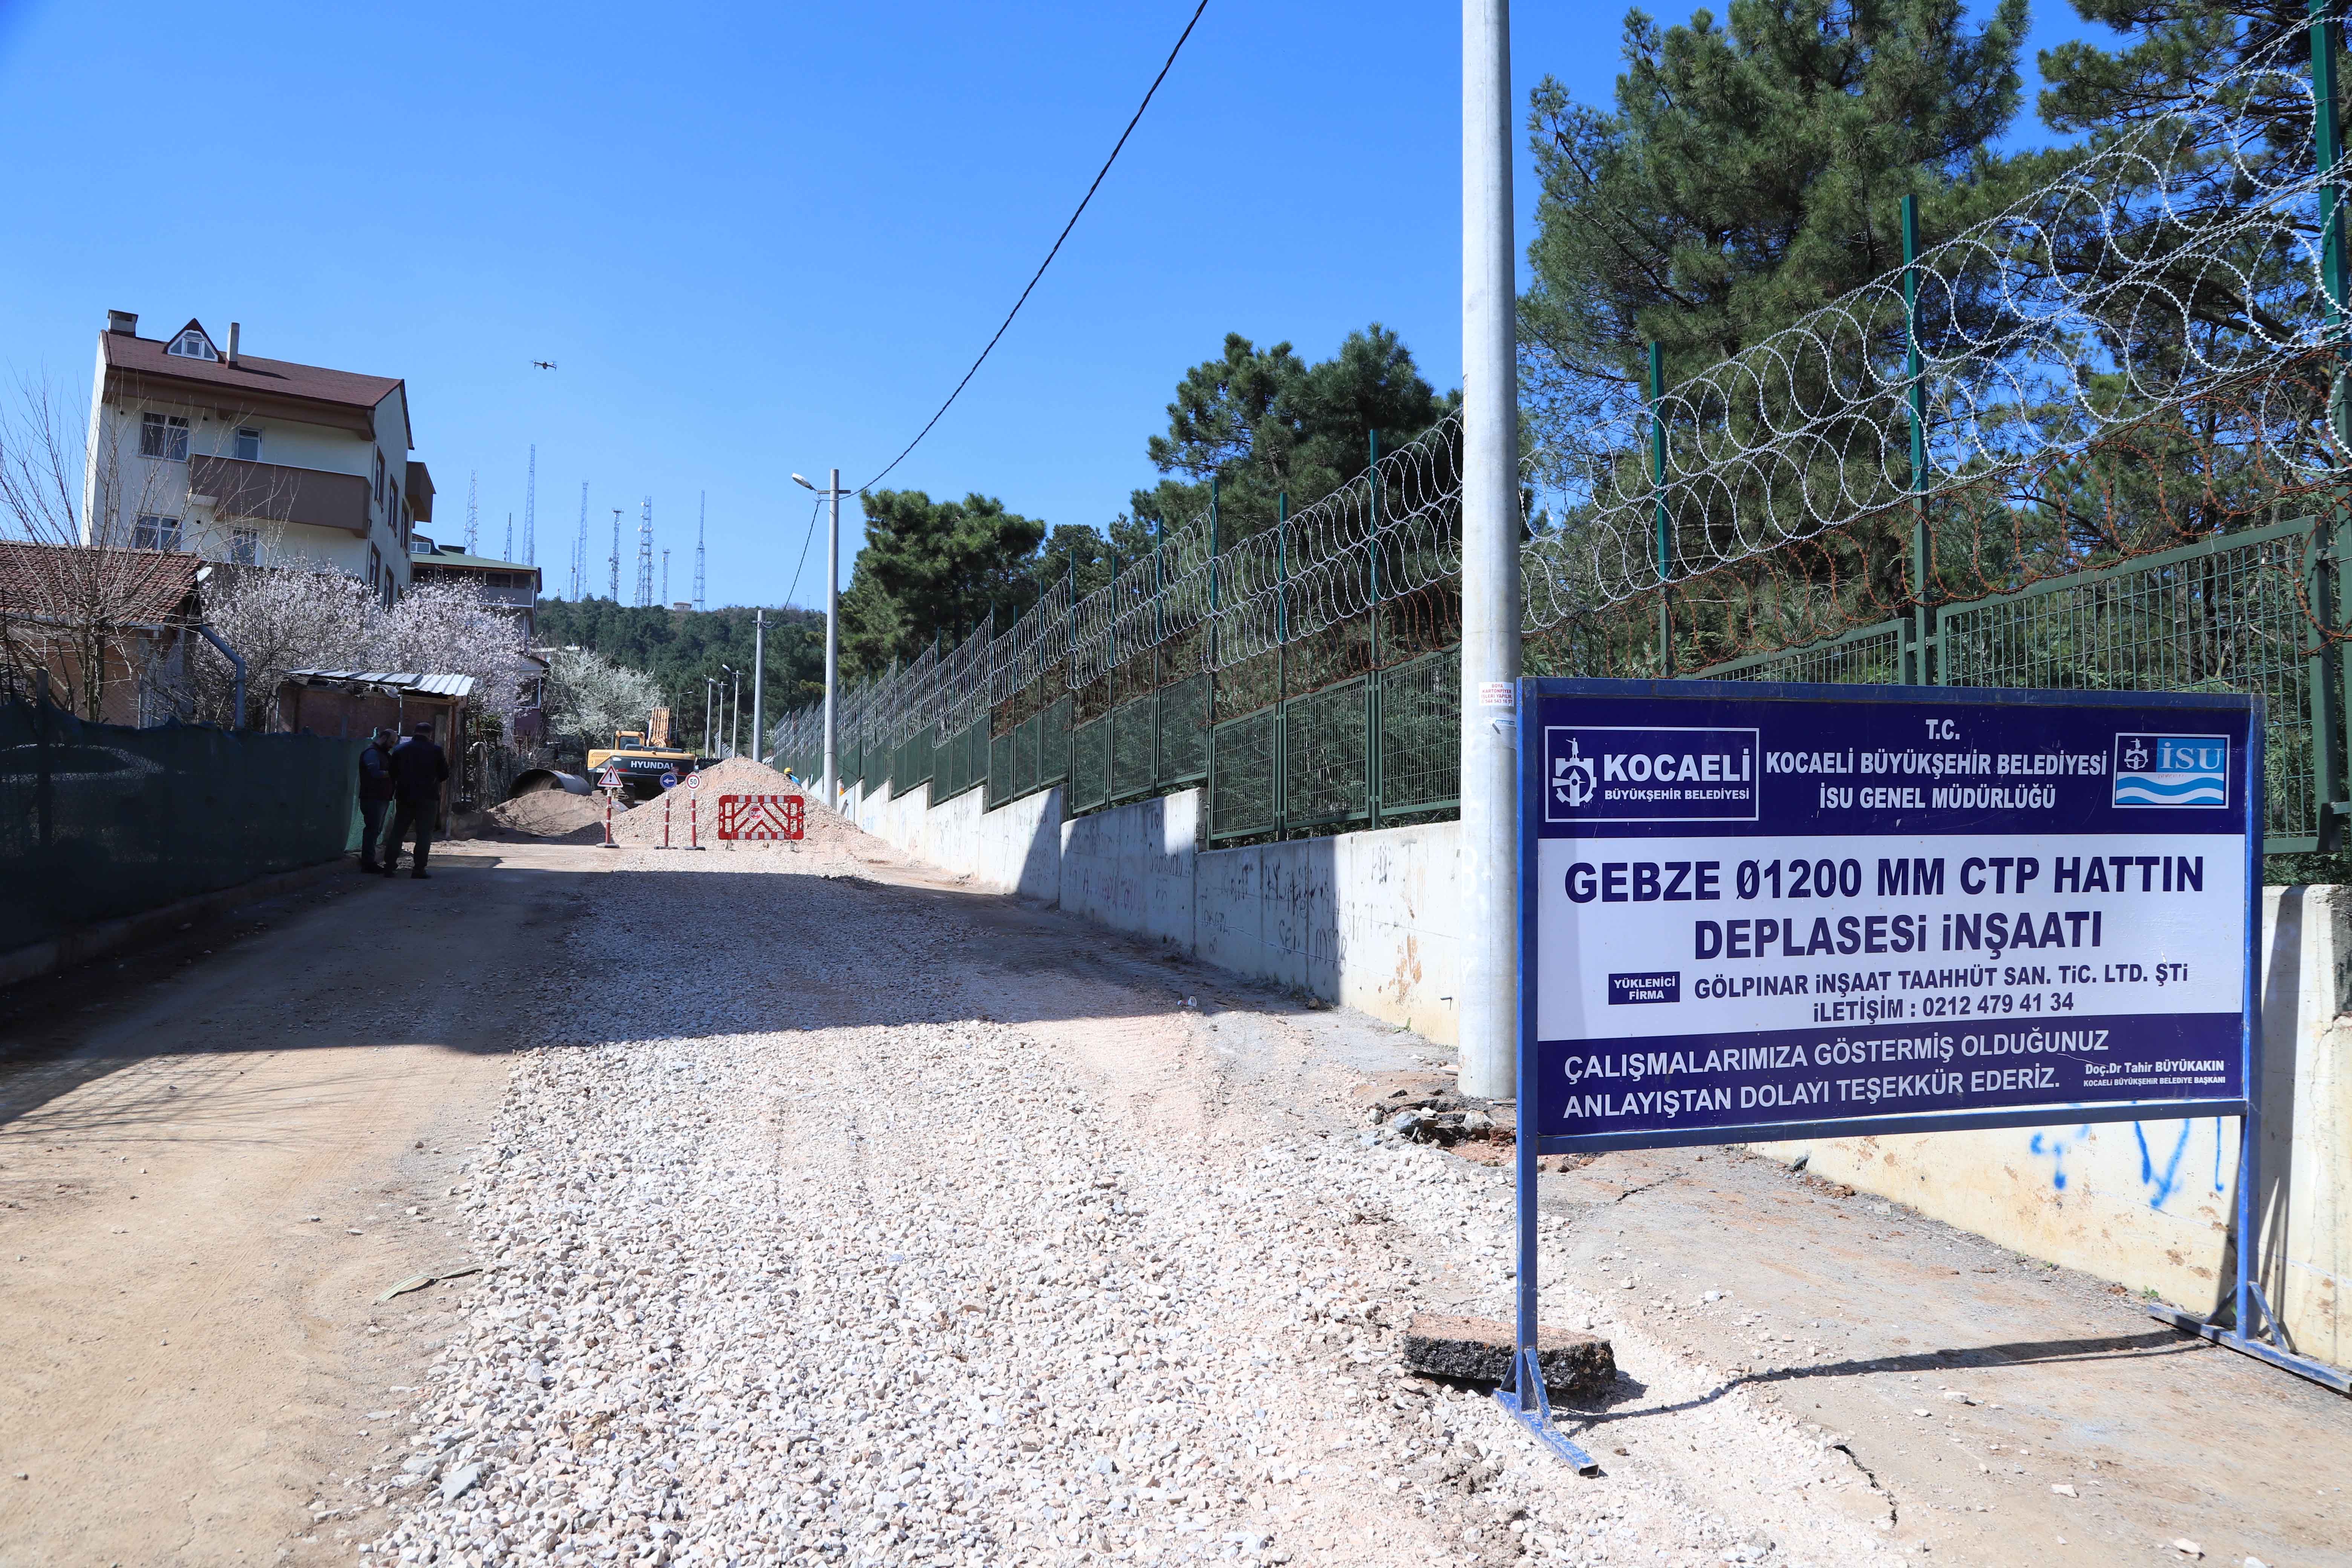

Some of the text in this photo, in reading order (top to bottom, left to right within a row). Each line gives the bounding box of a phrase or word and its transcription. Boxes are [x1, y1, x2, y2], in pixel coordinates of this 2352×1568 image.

[1925, 719, 1960, 740] T.C.
[631, 761, 673, 769] HYUNDAI
[1603, 748, 1750, 781] KOCAELİ
[1766, 747, 2107, 779] KOCAELİ BÜYÜKŞEHİR BELEDİYESİ
[2160, 742, 2224, 769] İSU
[1605, 788, 1750, 802] BÜYÜKŞEHİR BELEDİYESİ
[1820, 782, 2056, 808] İSU GENEL MÜDÜRLÜĞÜ
[1565, 856, 2203, 903] GEBZE Ø1200 MM CTP HATTIN
[1613, 977, 1676, 989] YÜKLENİCİ
[1694, 974, 1809, 999] GÖLPINAR
[1898, 964, 1997, 990] TAAHHÜT
[2003, 966, 2051, 986] SAN.
[2104, 964, 2148, 983] LTD.
[1628, 989, 1664, 1001] FİRMA
[1911, 1001, 1916, 1017] :
[1922, 996, 1971, 1017] 0212
[1977, 994, 2013, 1015] 479
[2019, 993, 2041, 1013] 41
[2050, 992, 2074, 1012] 34
[1564, 1027, 2109, 1085] ÇALIŞMALARIMIZA GÖSTERMİŞ OLDUĞUNUZ
[2085, 1059, 2225, 1077] Doç.Dr Tahir BÜYÜKAKIN
[1563, 1063, 2060, 1118] ANLAYIŞTAN DOLAYI TEŞEKKÜR EDERİZ.
[2194, 1076, 2226, 1085] BAŞKANI
